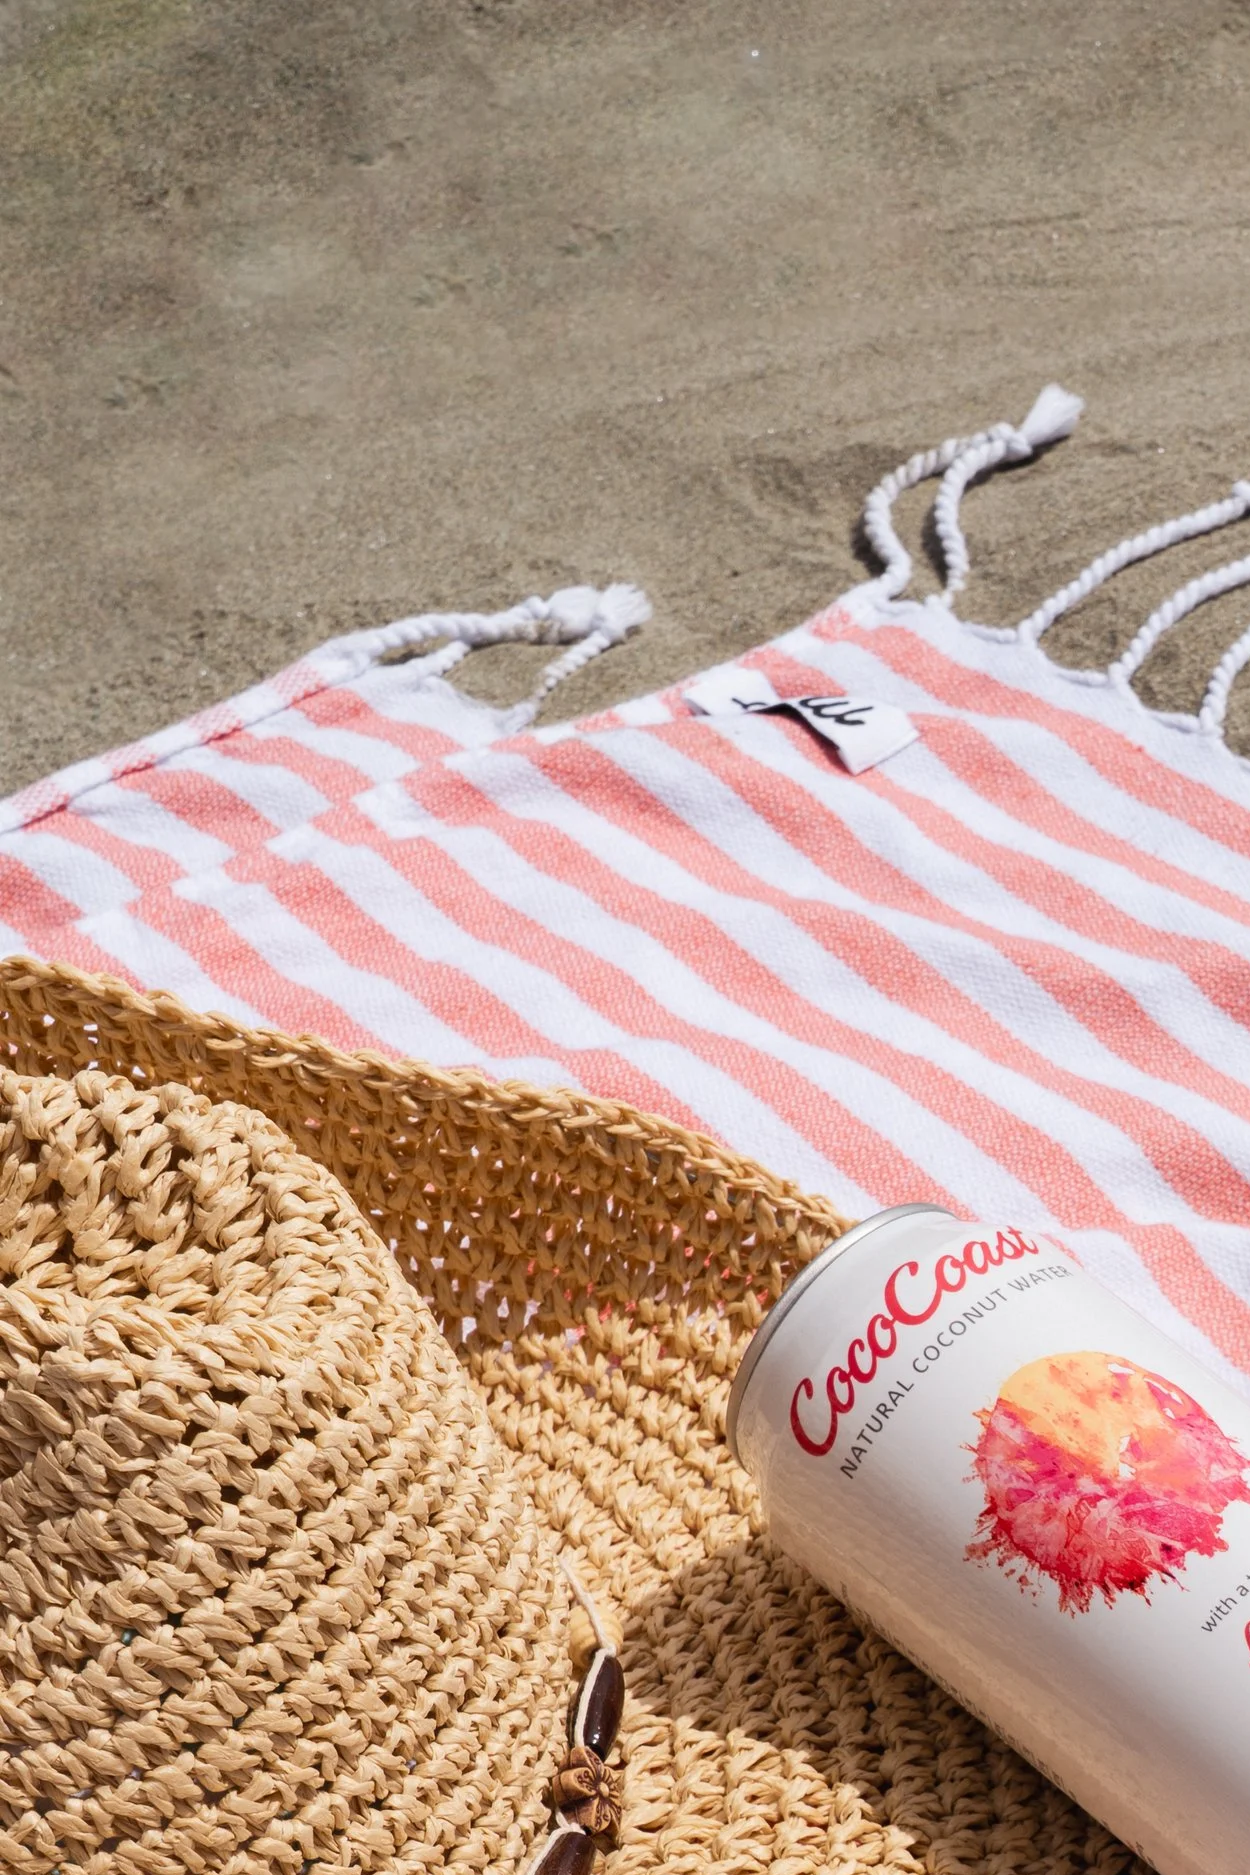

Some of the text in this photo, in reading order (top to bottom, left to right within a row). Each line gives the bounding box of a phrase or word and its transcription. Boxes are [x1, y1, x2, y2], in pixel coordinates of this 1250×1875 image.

[790, 1225, 1039, 1457] CocoCoast
[839, 1265, 1072, 1479] NATURAL COCONUT WATER
[1201, 1593, 1237, 1634] with
[1236, 1582, 1250, 1598] a
